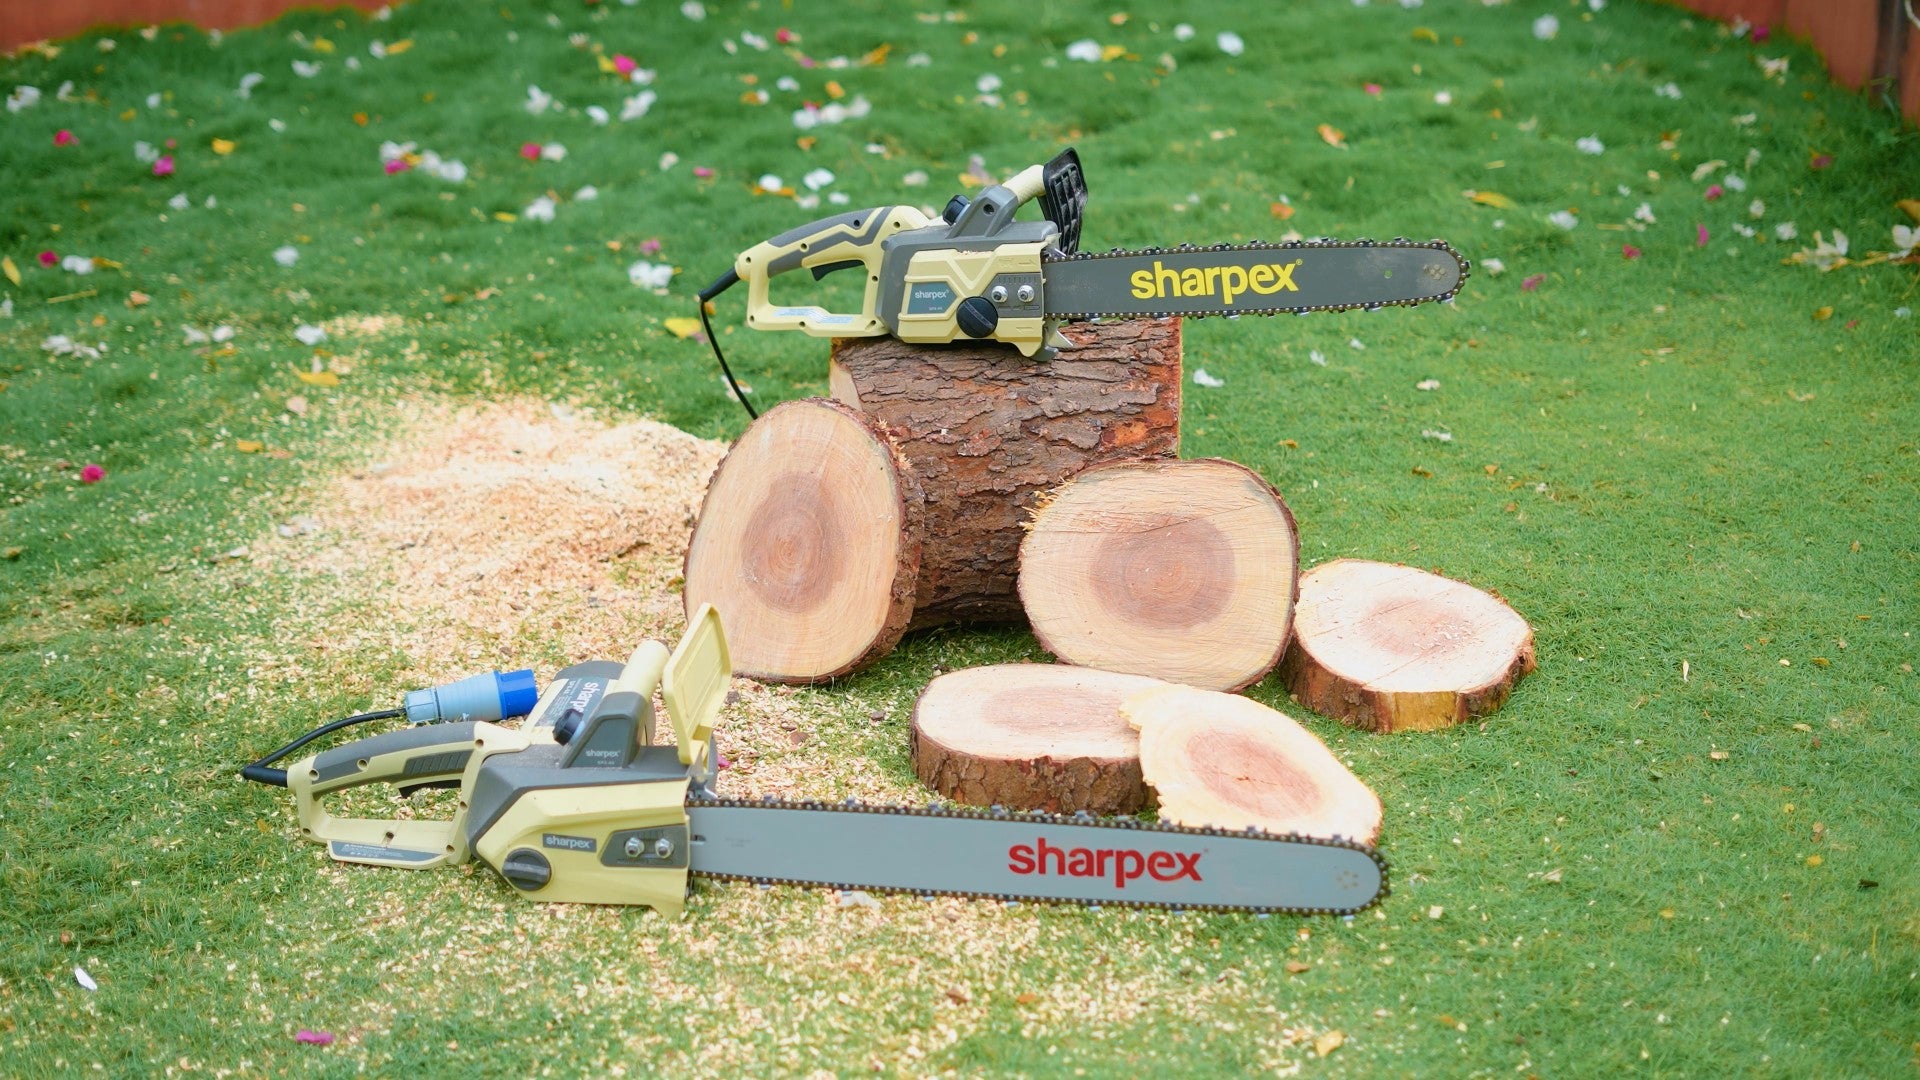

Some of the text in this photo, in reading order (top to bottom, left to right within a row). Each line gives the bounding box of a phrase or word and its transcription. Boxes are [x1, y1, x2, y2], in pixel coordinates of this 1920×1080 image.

[1130, 260, 1300, 304] sharpex
[914, 290, 947, 300] sharpex
[570, 681, 600, 713] sharpe
[585, 749, 619, 758] sharpex
[546, 835, 590, 849] sharpex
[1008, 837, 1203, 888] sharpex
